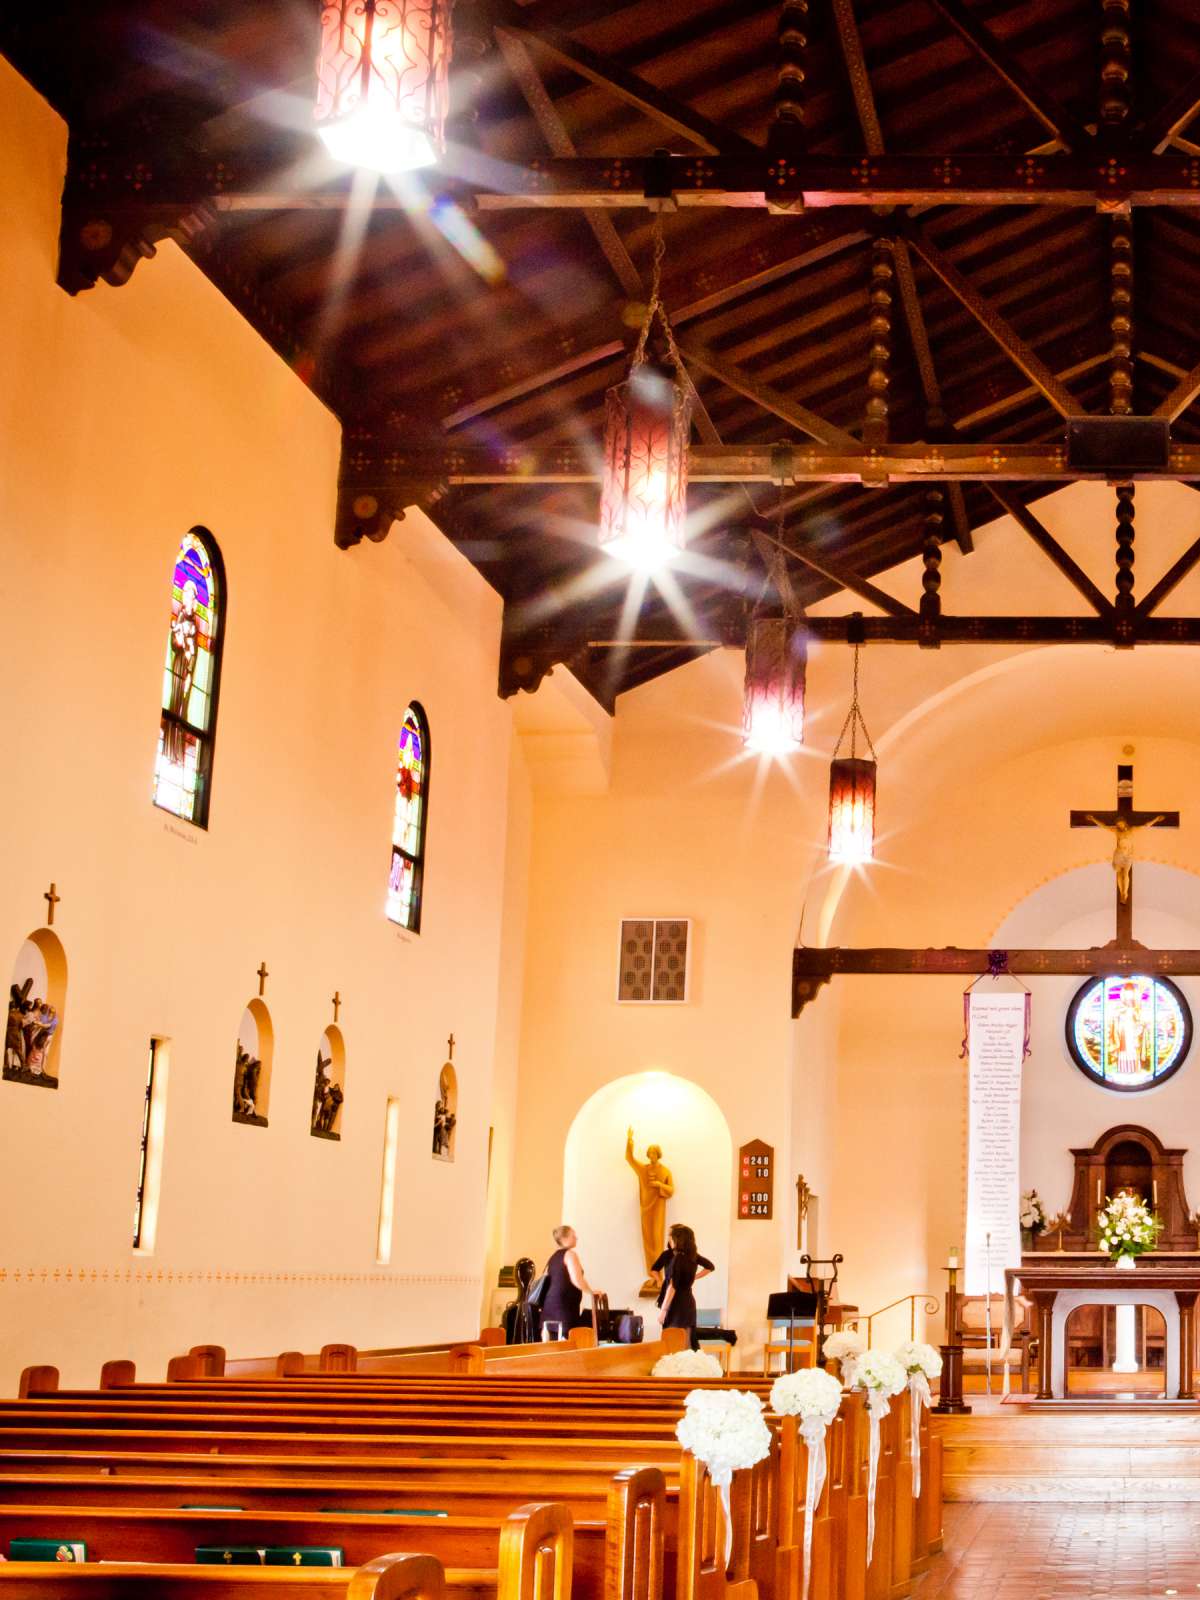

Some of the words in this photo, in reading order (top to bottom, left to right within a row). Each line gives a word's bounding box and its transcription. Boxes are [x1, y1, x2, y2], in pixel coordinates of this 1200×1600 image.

[758, 1169, 768, 1177] 10
[752, 1193, 768, 1202] 100
[751, 1205, 767, 1214] 244
